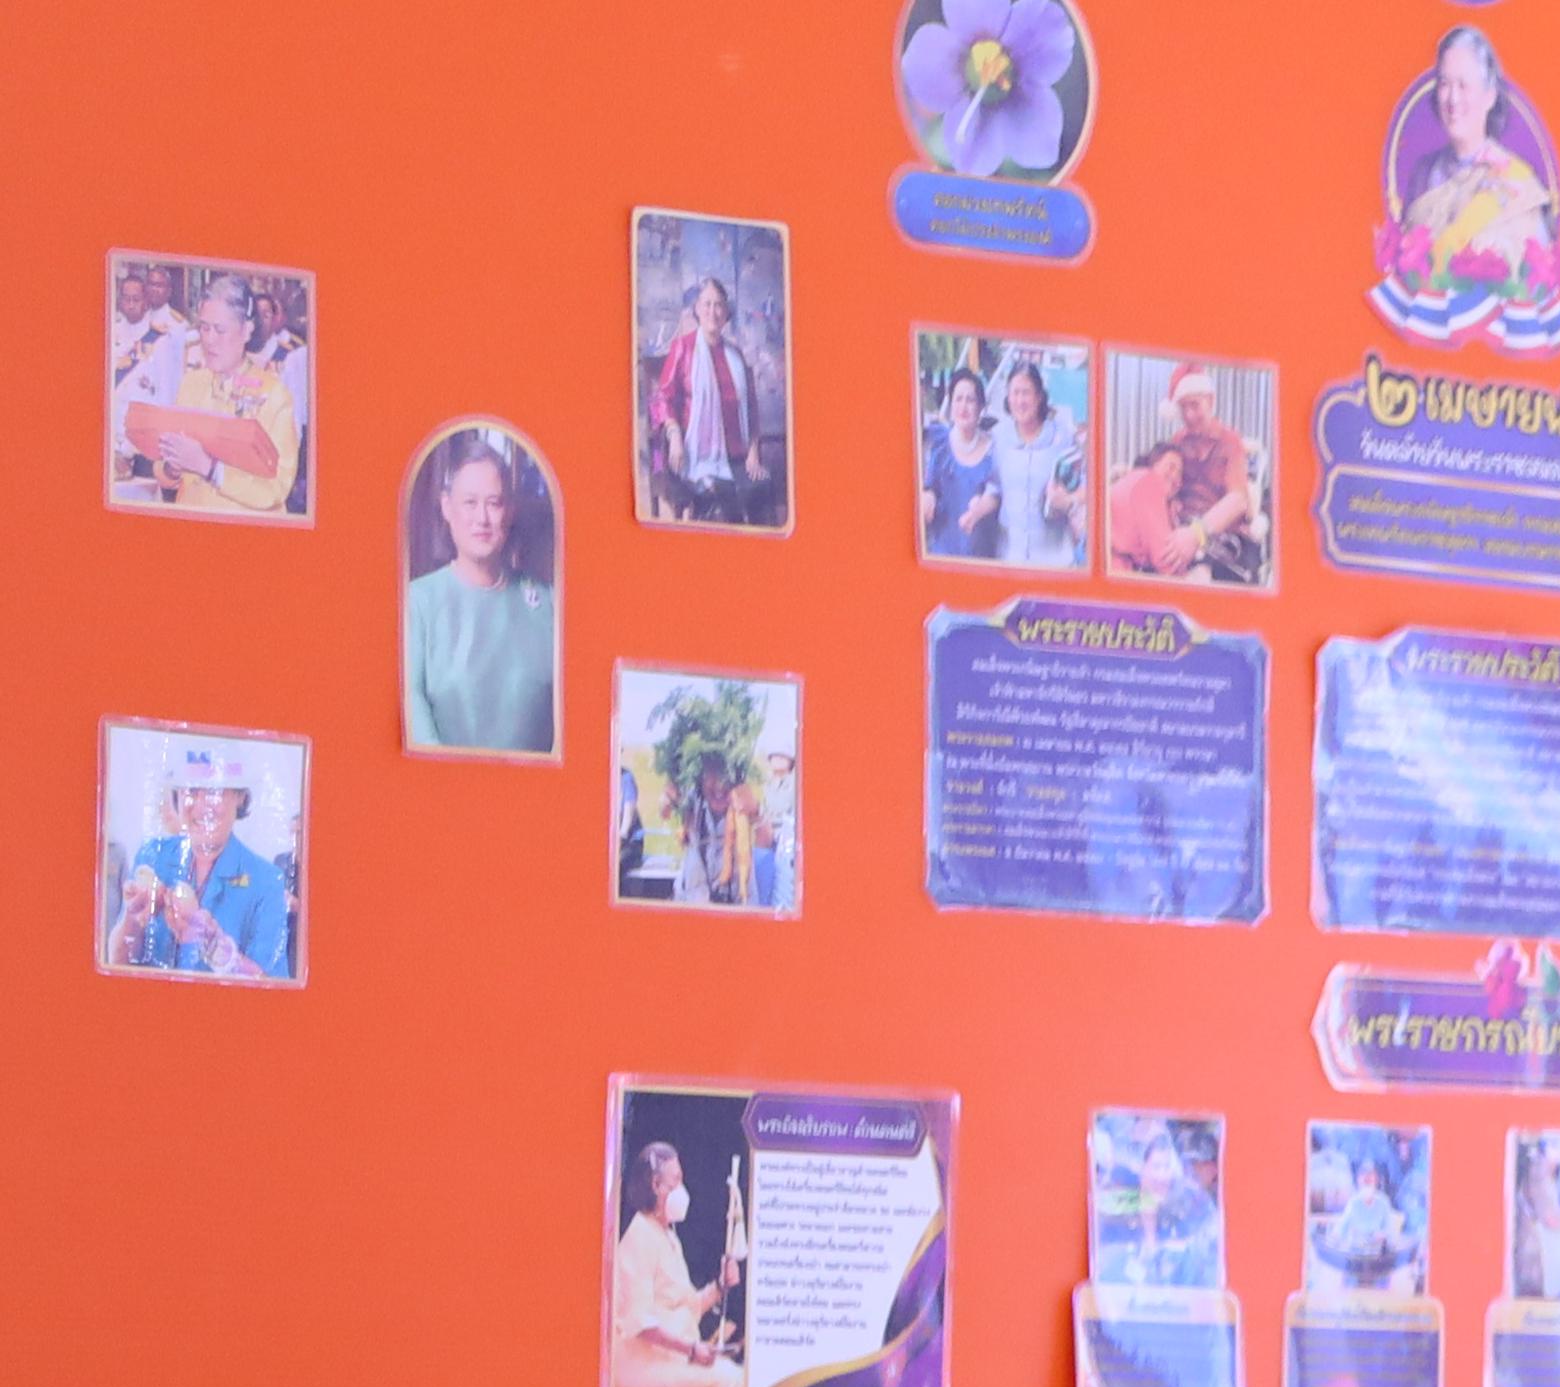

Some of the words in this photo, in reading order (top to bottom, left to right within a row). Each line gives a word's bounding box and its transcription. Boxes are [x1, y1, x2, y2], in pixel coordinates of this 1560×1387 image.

[1018, 614, 1176, 654] พระราชประวัติ
